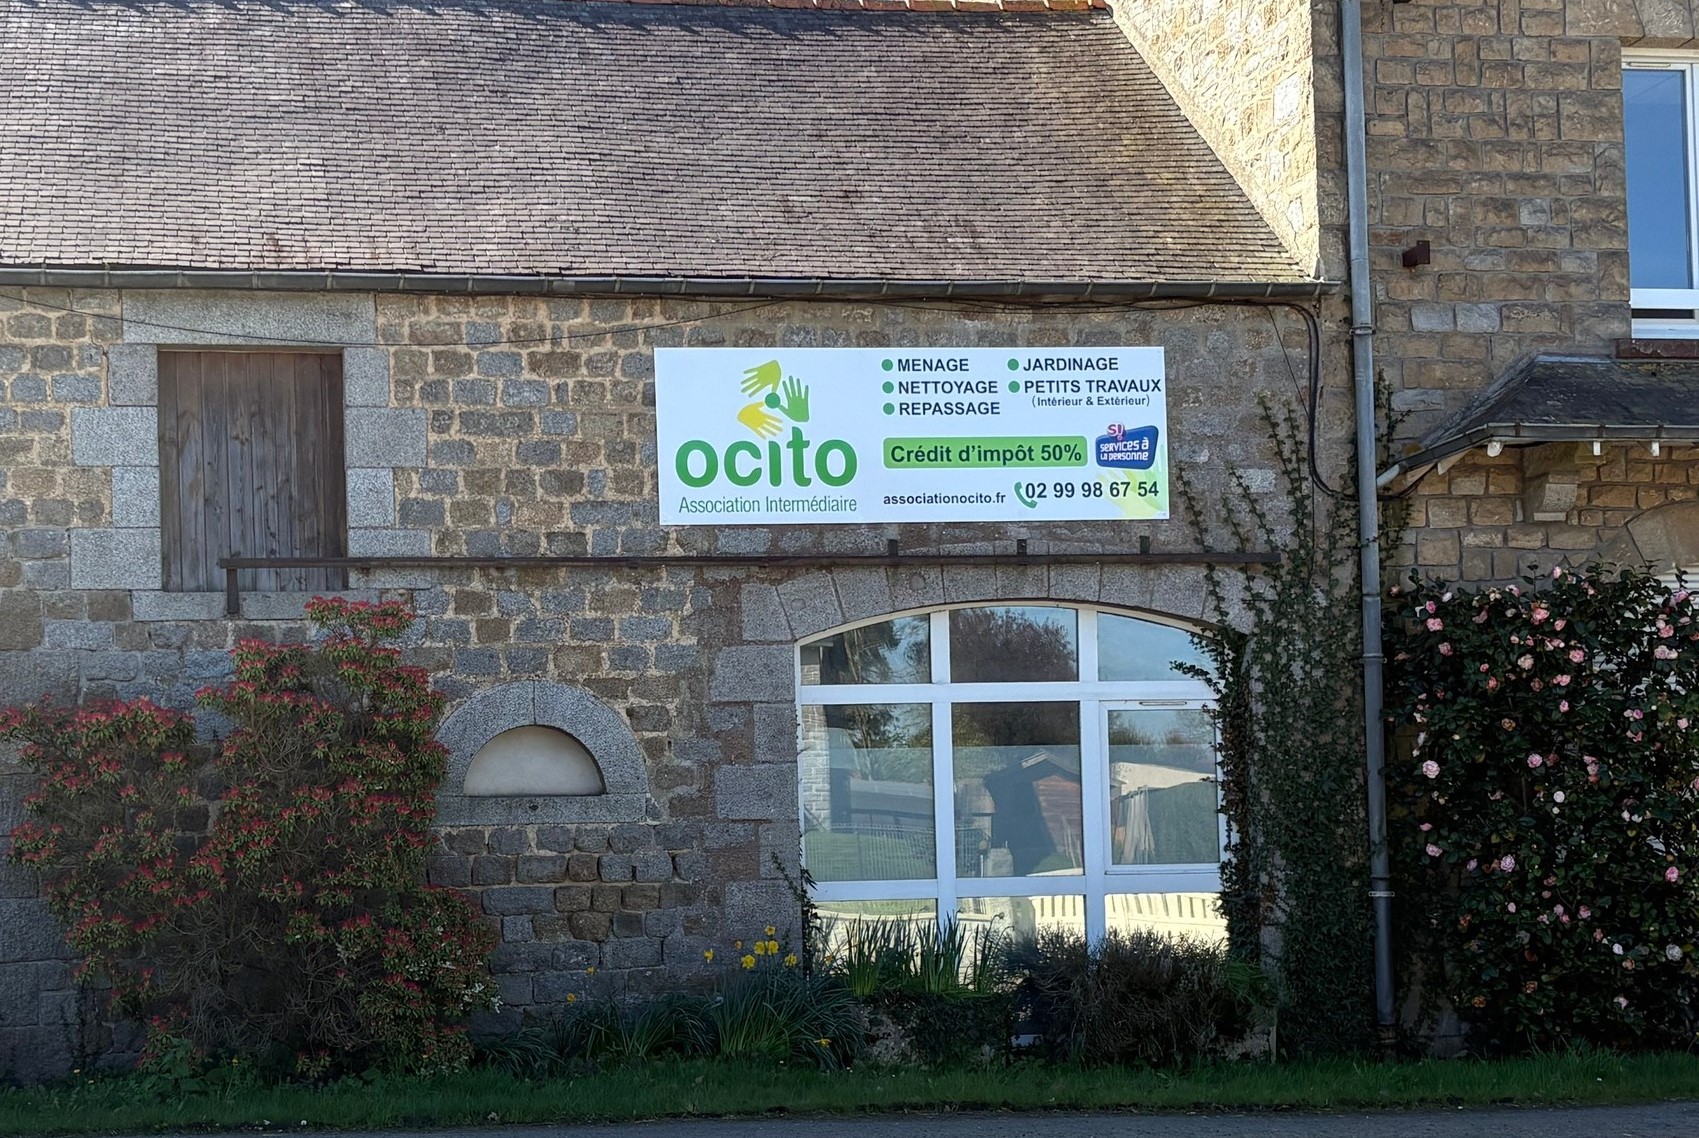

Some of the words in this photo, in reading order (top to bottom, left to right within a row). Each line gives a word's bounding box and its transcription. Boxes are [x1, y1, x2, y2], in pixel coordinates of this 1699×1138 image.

[898, 358, 970, 372] MENAGE
[1023, 357, 1119, 371] JARDINAGE
[898, 381, 998, 394] NETTOYAGE
[1024, 380, 1081, 393] PETITS
[1085, 379, 1161, 393] TRAVAUX
[1031, 395, 1082, 408] (Intérieur
[1085, 396, 1094, 406] &
[1096, 394, 1150, 407] Extérieur)
[899, 402, 1000, 415] REPASSAGE
[1141, 436, 1149, 450] à
[675, 426, 858, 488] ocito
[890, 445, 952, 463] Crédit
[1040, 444, 1082, 462] 50%
[1025, 482, 1047, 499] 02
[1053, 482, 1075, 498] 99
[1081, 481, 1103, 498] 98
[1109, 481, 1131, 497] 67
[1137, 480, 1160, 497] 54
[678, 496, 761, 513] Association
[766, 495, 858, 512] Intermédiaire
[883, 492, 1006, 505] associationocito.fr
